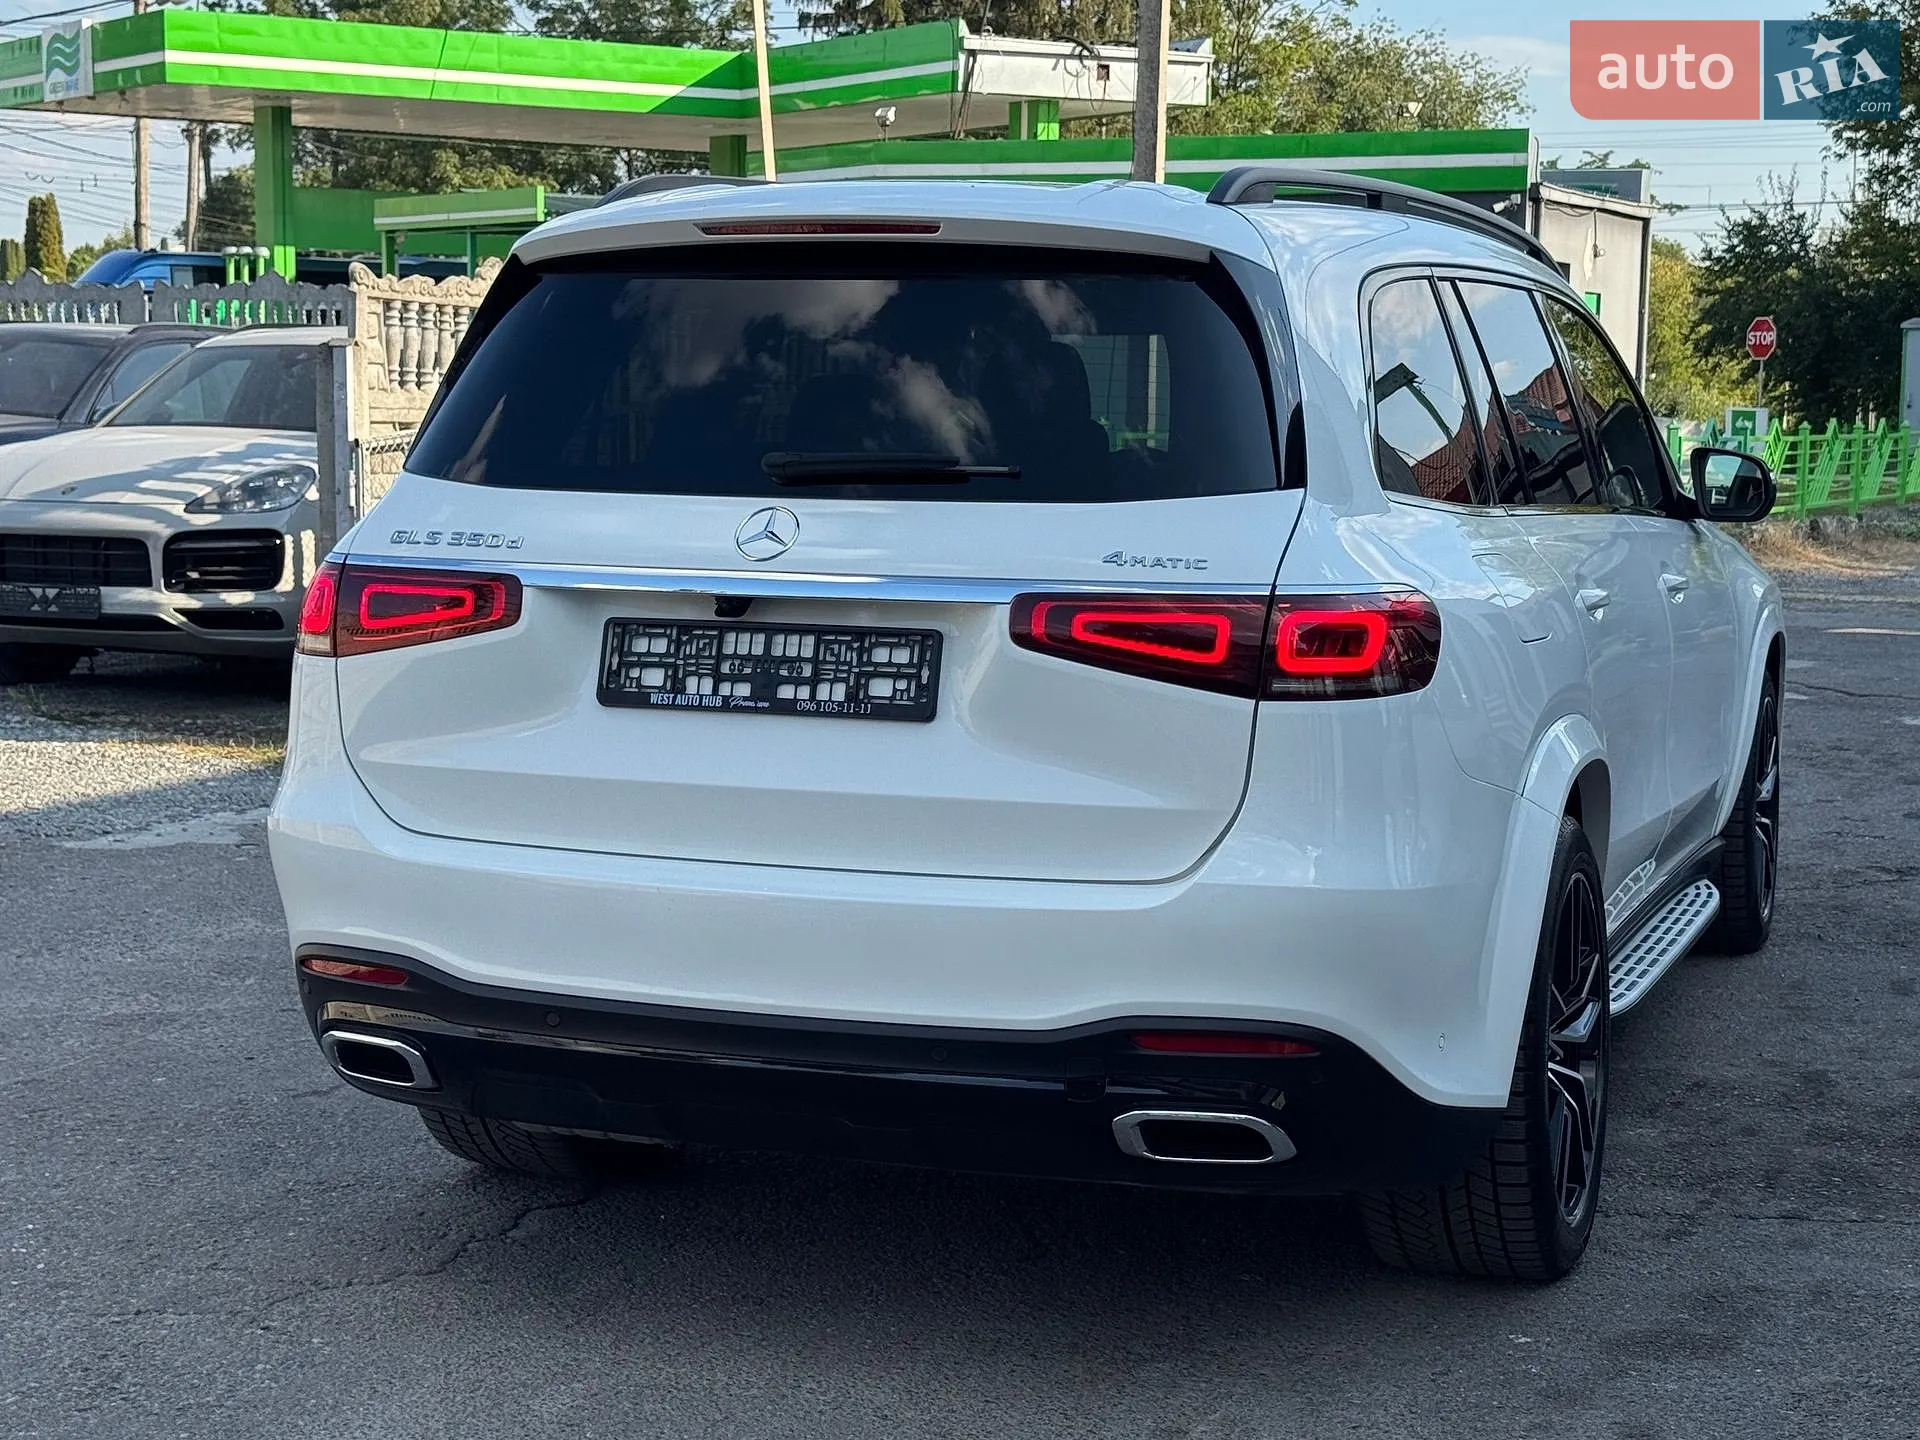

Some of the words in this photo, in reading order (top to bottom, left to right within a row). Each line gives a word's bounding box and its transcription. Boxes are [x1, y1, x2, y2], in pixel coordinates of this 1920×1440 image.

[1748, 331, 1774, 346] STOP
[390, 529, 442, 546] GLS
[447, 531, 525, 550] 350d
[1101, 550, 1208, 570] 4MATIC
[650, 693, 678, 706] WEST
[676, 694, 700, 706] AUTO
[701, 695, 723, 707] HUB
[796, 700, 817, 712] 096
[819, 701, 872, 714] 105-11-11
